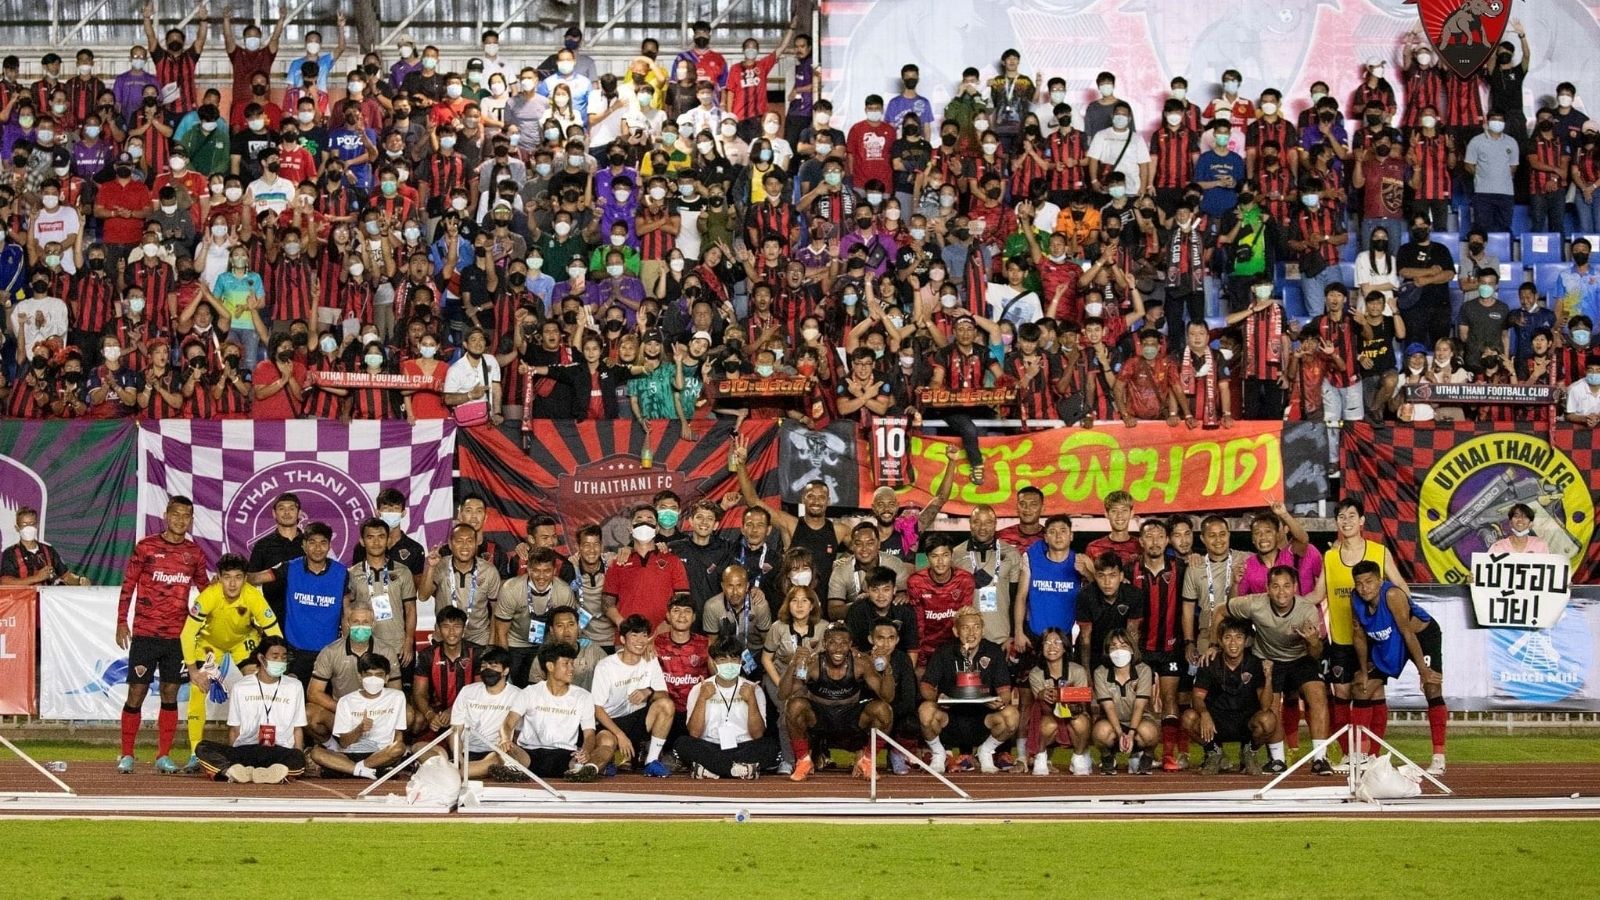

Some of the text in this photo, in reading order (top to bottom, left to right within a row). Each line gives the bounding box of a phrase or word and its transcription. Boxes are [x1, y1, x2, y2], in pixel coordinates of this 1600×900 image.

[320, 371, 433, 383] UTHAI THANI FOOTBALL CLUB
[1436, 385, 1549, 397] UTHAI THANI FOOTBALL CLUB
[875, 427, 906, 458] 10
[1433, 440, 1576, 490] UTHAI THANI FC
[574, 475, 673, 495] UTHAITHANI FC
[235, 476, 279, 525] UTHAI
[284, 470, 347, 497] THANI
[152, 571, 192, 584] Fitogether
[1475, 552, 1569, 594] เข้ารอบ
[1033, 580, 1074, 589] UTHAI THANI
[294, 592, 336, 604] UTHAI THANI
[243, 639, 256, 651] 18
[1500, 671, 1578, 683] Dutch Mill
